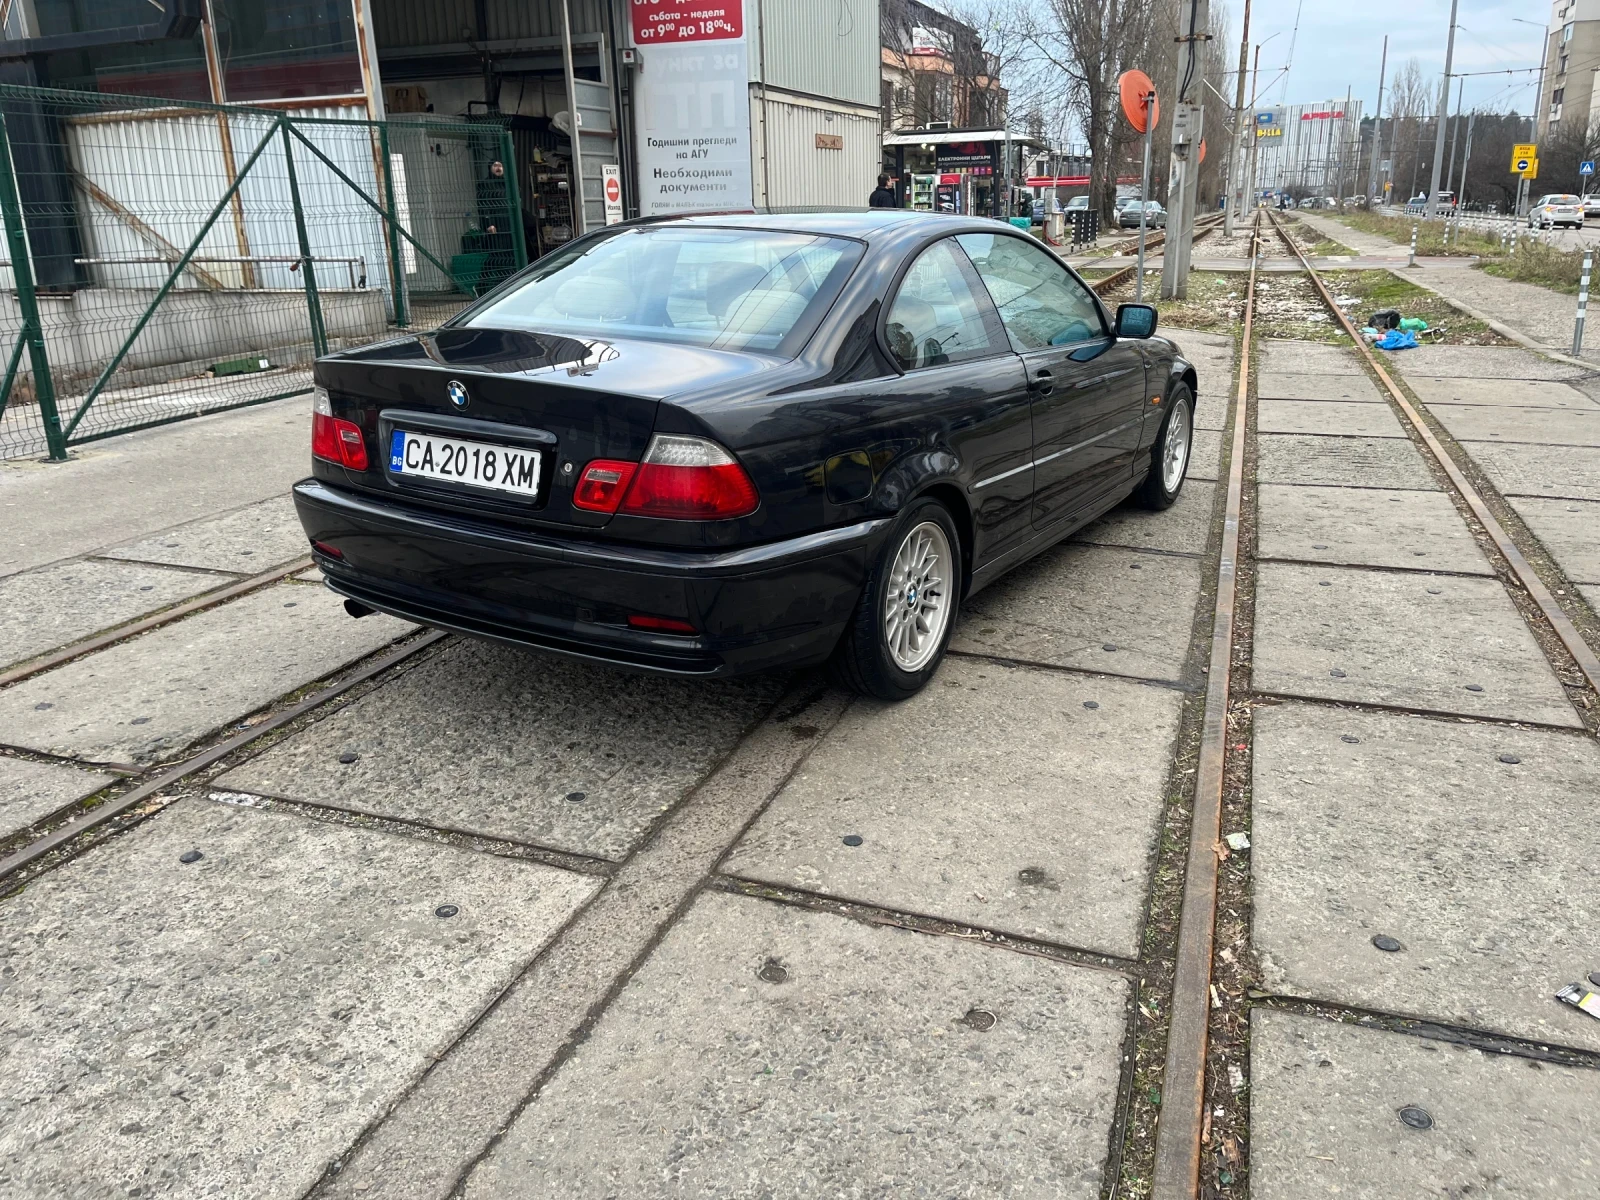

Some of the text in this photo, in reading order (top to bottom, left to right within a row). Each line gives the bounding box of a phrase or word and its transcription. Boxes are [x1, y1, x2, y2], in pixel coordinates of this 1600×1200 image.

[649, 11, 680, 21] събота
[691, 9, 725, 19] неделя
[641, 28, 655, 38] от
[678, 25, 696, 37] до
[647, 137, 737, 148] Годишни прегледи
[691, 149, 708, 159] АГУ
[653, 167, 732, 179] Необходими
[660, 183, 727, 194] документи
[447, 382, 465, 392] BMW
[392, 456, 403, 465] BG
[439, 443, 497, 482] 2018
